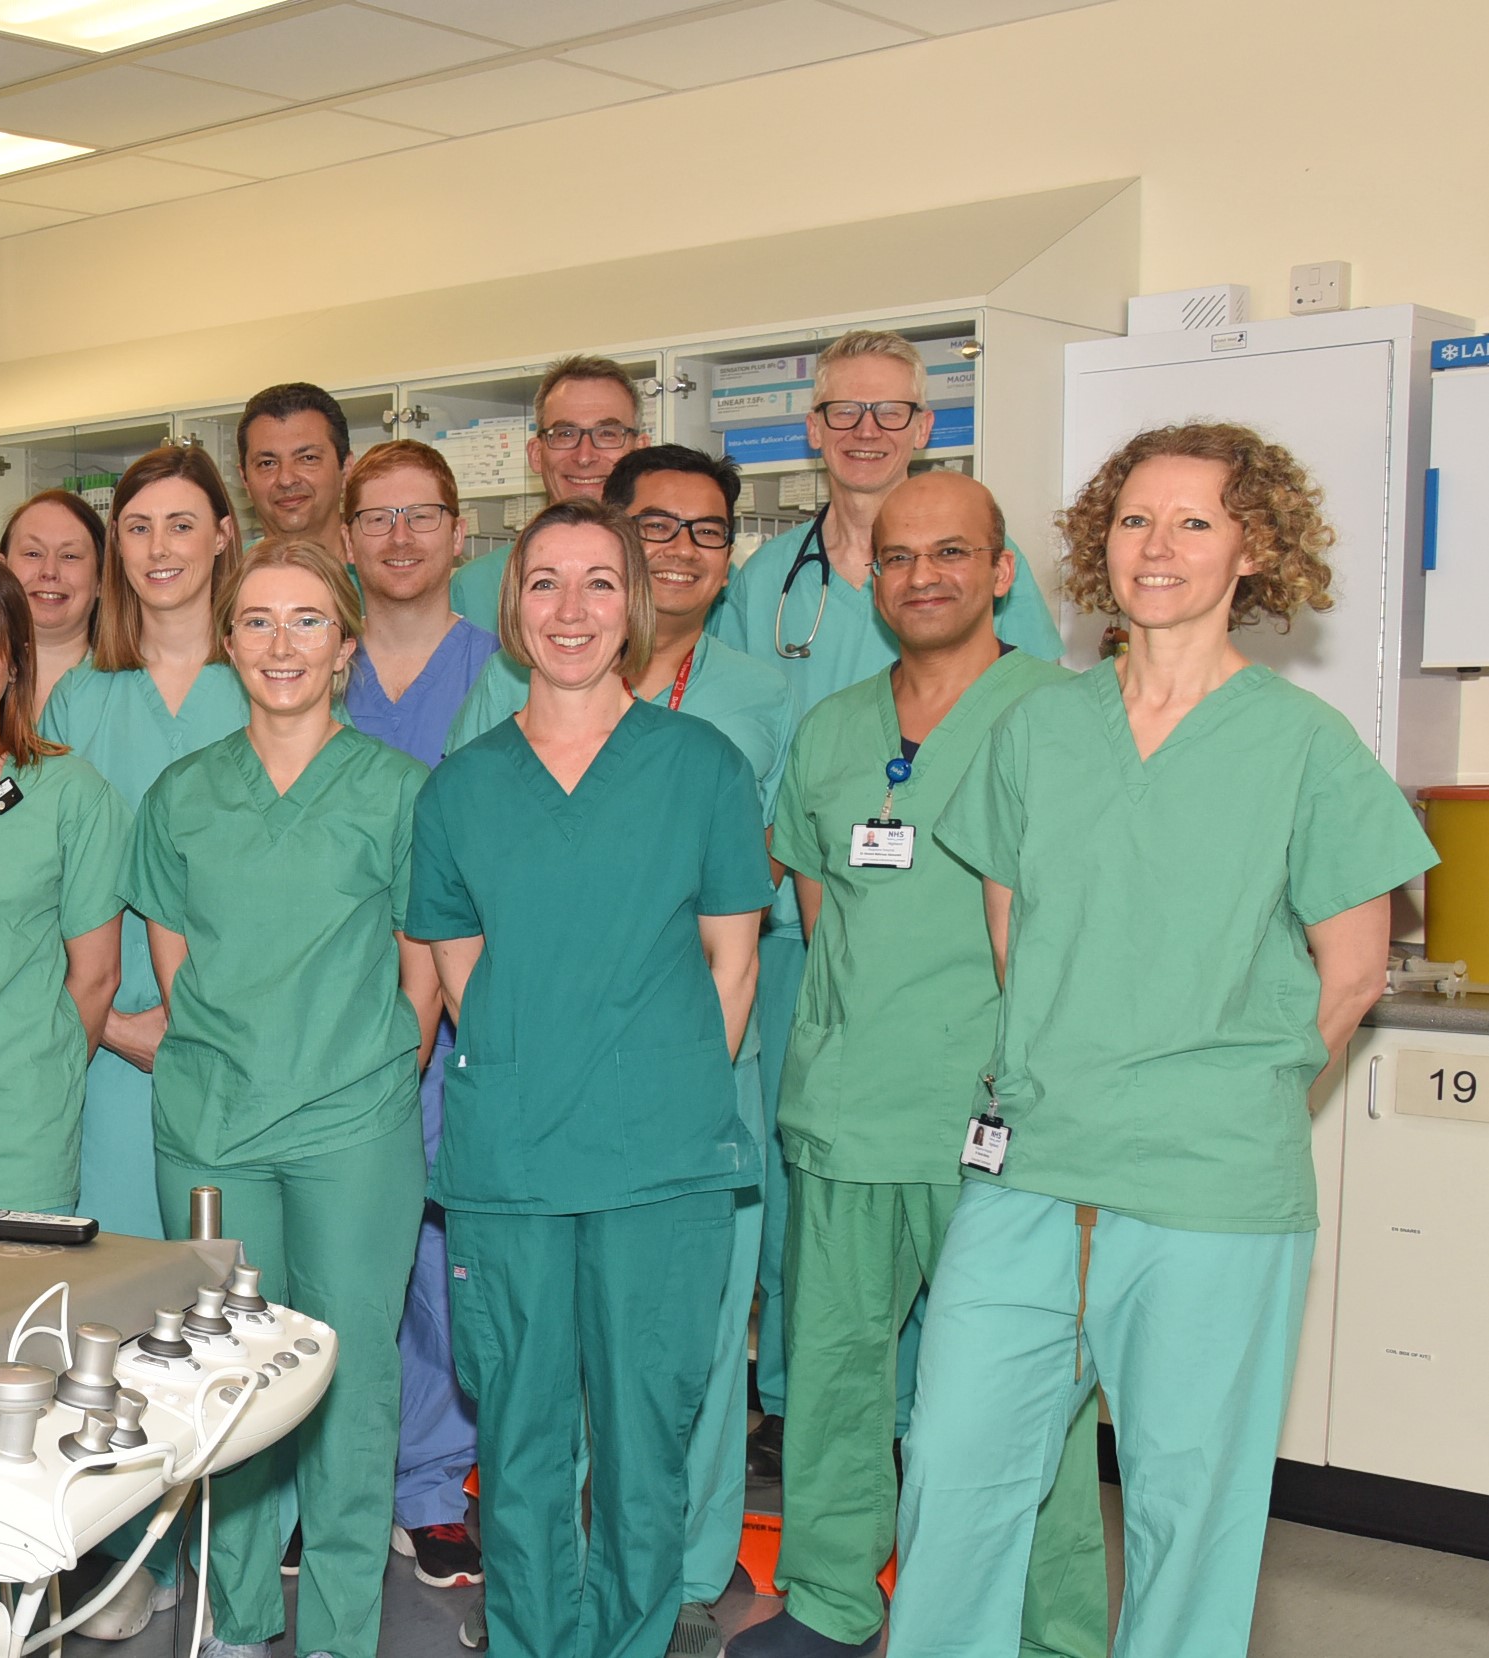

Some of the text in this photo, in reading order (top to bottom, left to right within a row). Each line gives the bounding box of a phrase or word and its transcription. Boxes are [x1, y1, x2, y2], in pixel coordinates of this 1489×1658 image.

[1461, 342, 1489, 358] LA
[717, 398, 745, 407] LINEAR
[1430, 1068, 1477, 1103] 19
[991, 1130, 1002, 1140] NHS
